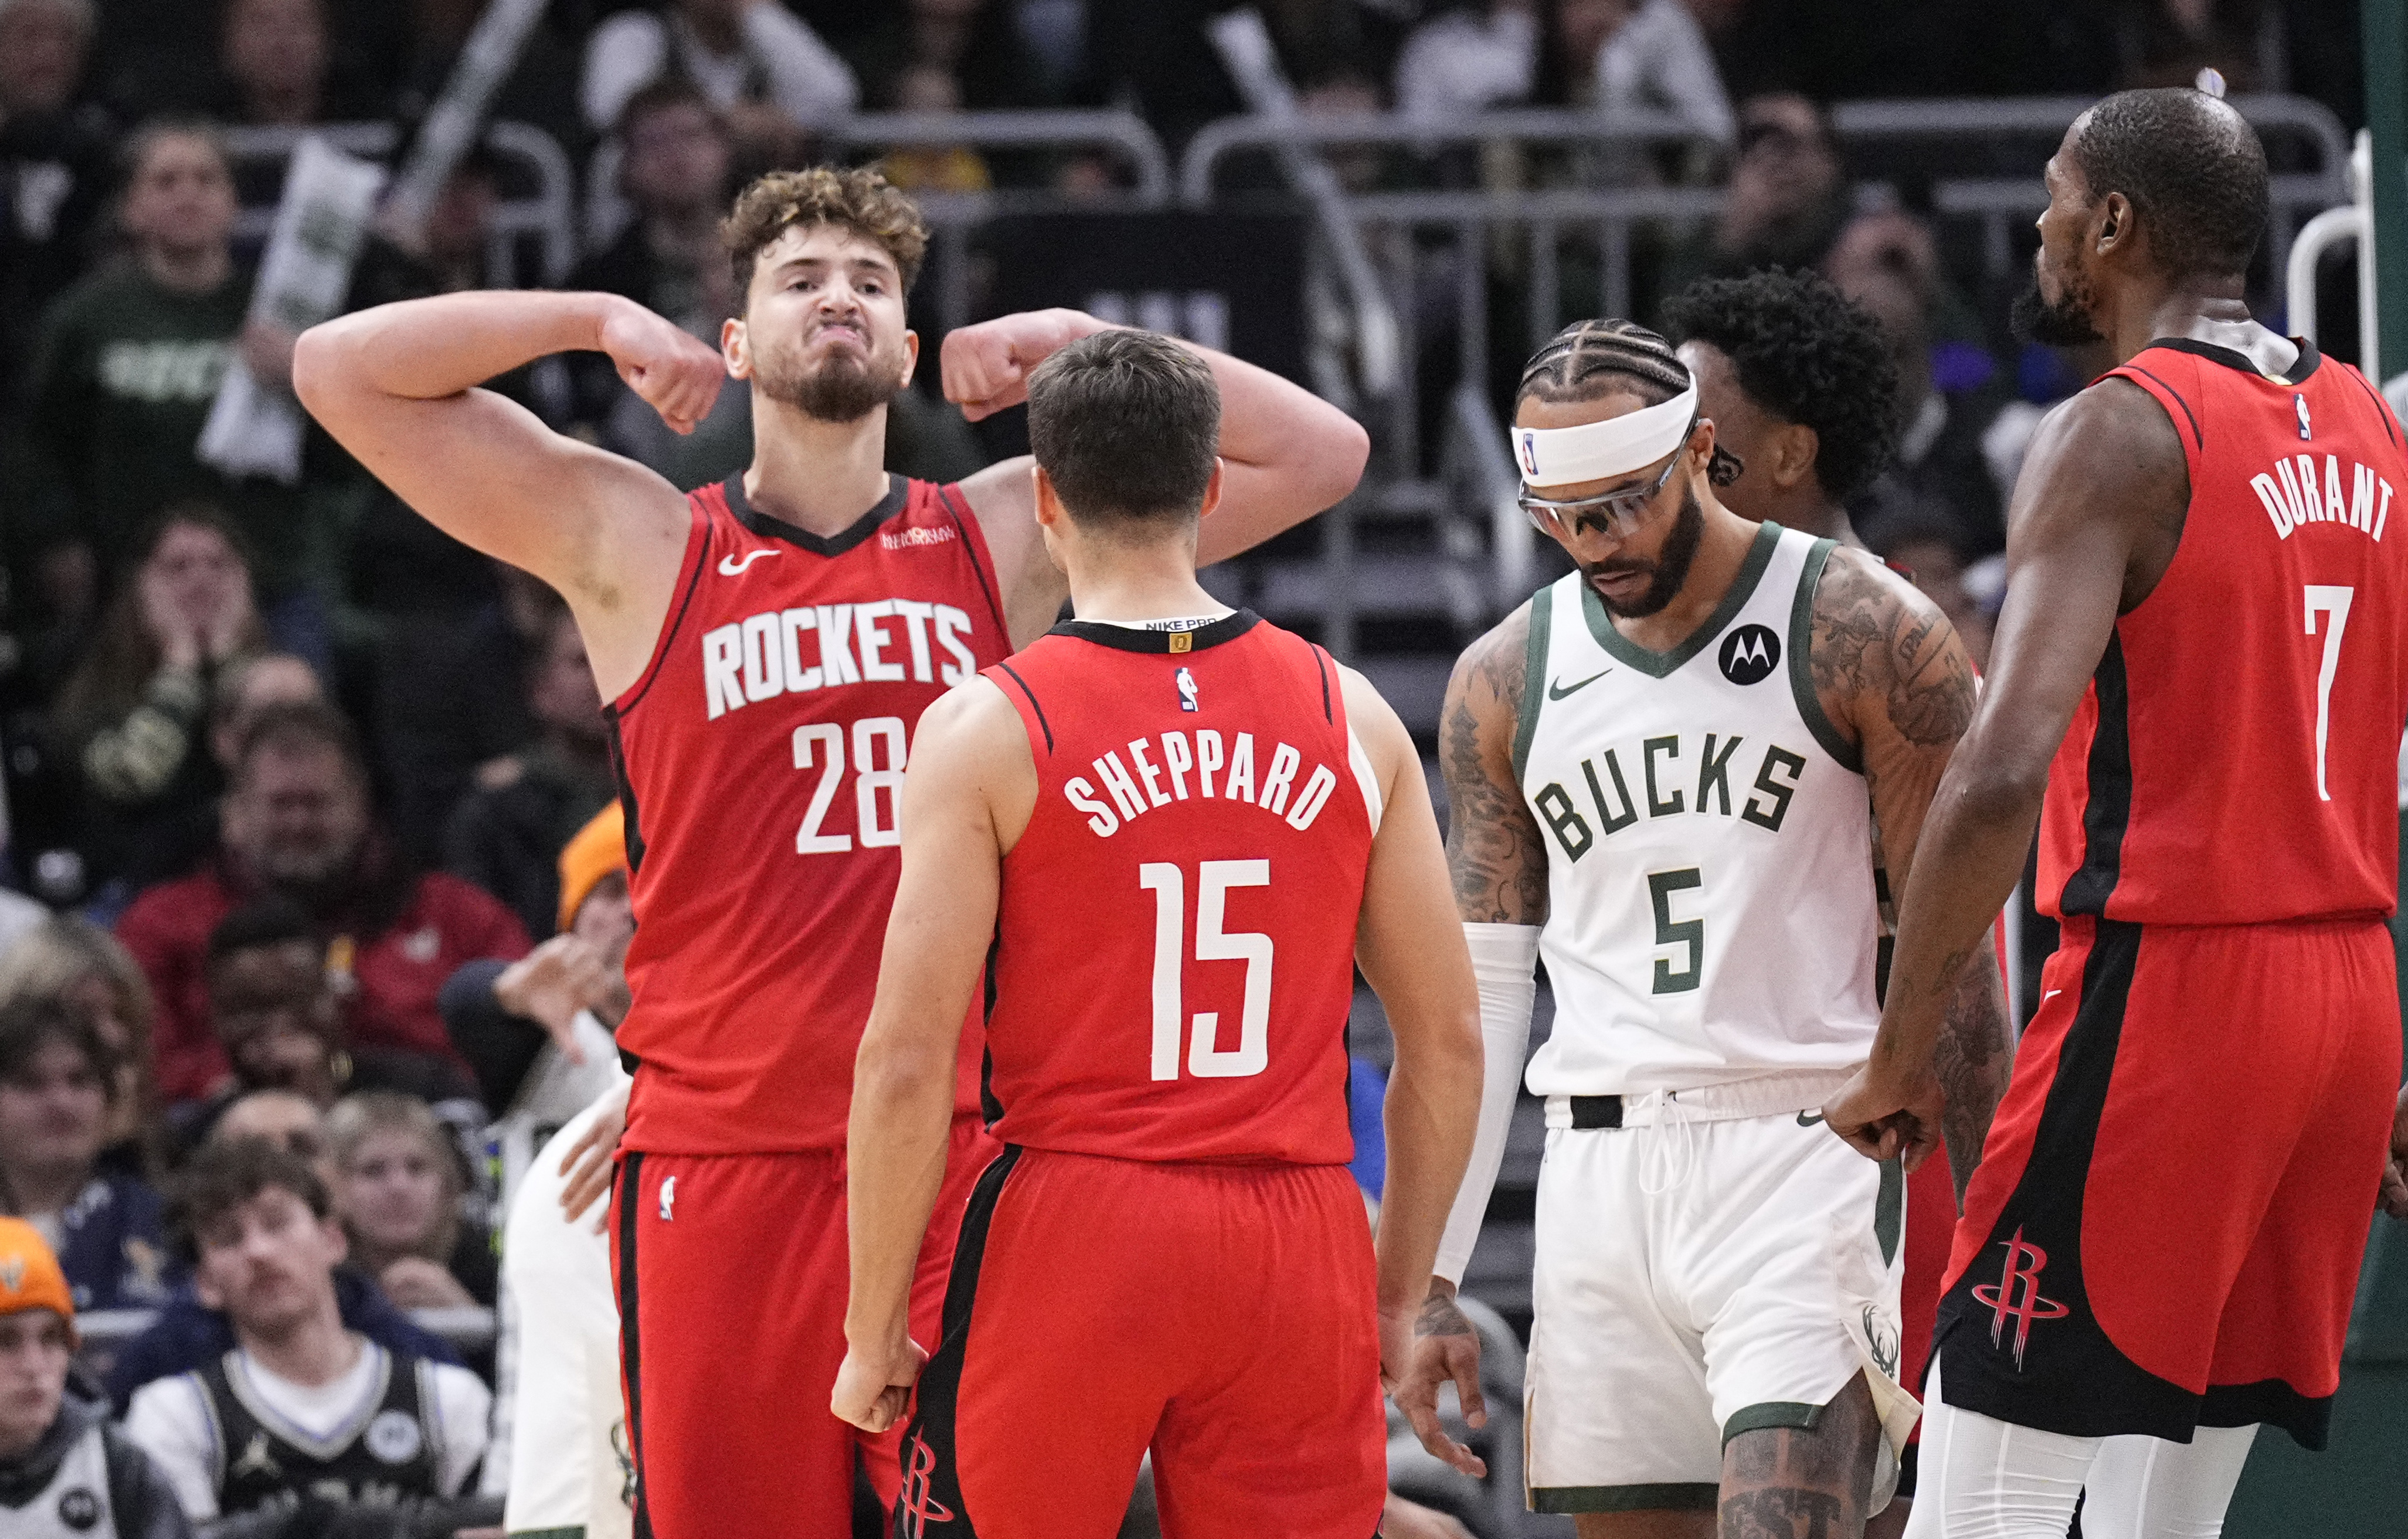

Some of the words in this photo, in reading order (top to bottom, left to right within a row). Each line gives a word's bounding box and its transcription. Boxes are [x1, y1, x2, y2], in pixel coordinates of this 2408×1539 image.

[2249, 453, 2393, 543] DURANT
[703, 598, 977, 721] ROCKETS
[1146, 620, 1183, 631] NIKE
[2304, 584, 2355, 801] 7
[792, 716, 908, 855] 28
[1064, 729, 1337, 838] SHEPPARD
[1533, 732, 1807, 865] BUCKS
[1139, 858, 1274, 1082] 15
[1647, 867, 1704, 995] 5
